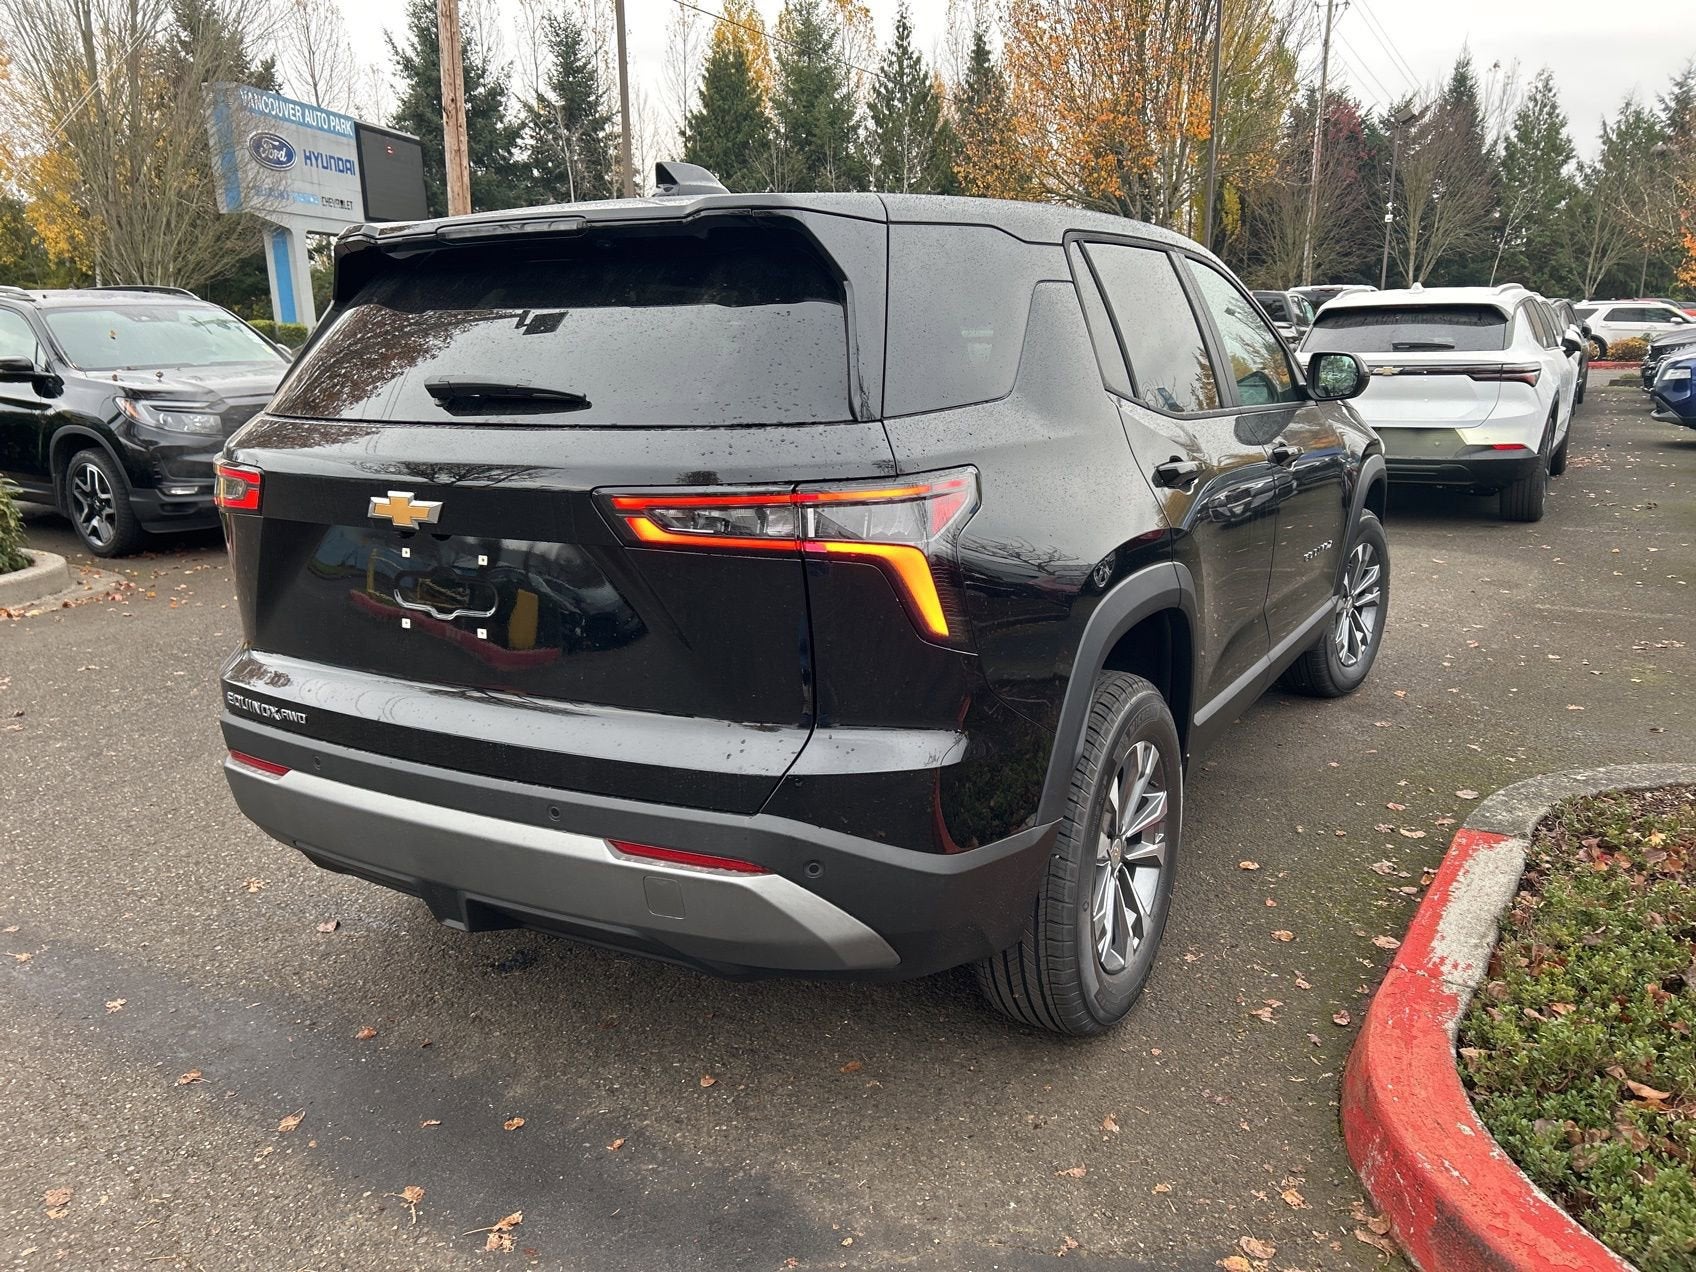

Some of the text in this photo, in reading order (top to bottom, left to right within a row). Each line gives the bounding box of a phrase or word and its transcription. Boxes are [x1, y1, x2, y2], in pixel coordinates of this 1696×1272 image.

[240, 90, 353, 136] VANCOUVER AUTO PARK
[260, 138, 288, 162] Ford
[303, 148, 356, 176] HYUNDAI
[226, 691, 307, 725] EQUINOX AWD
